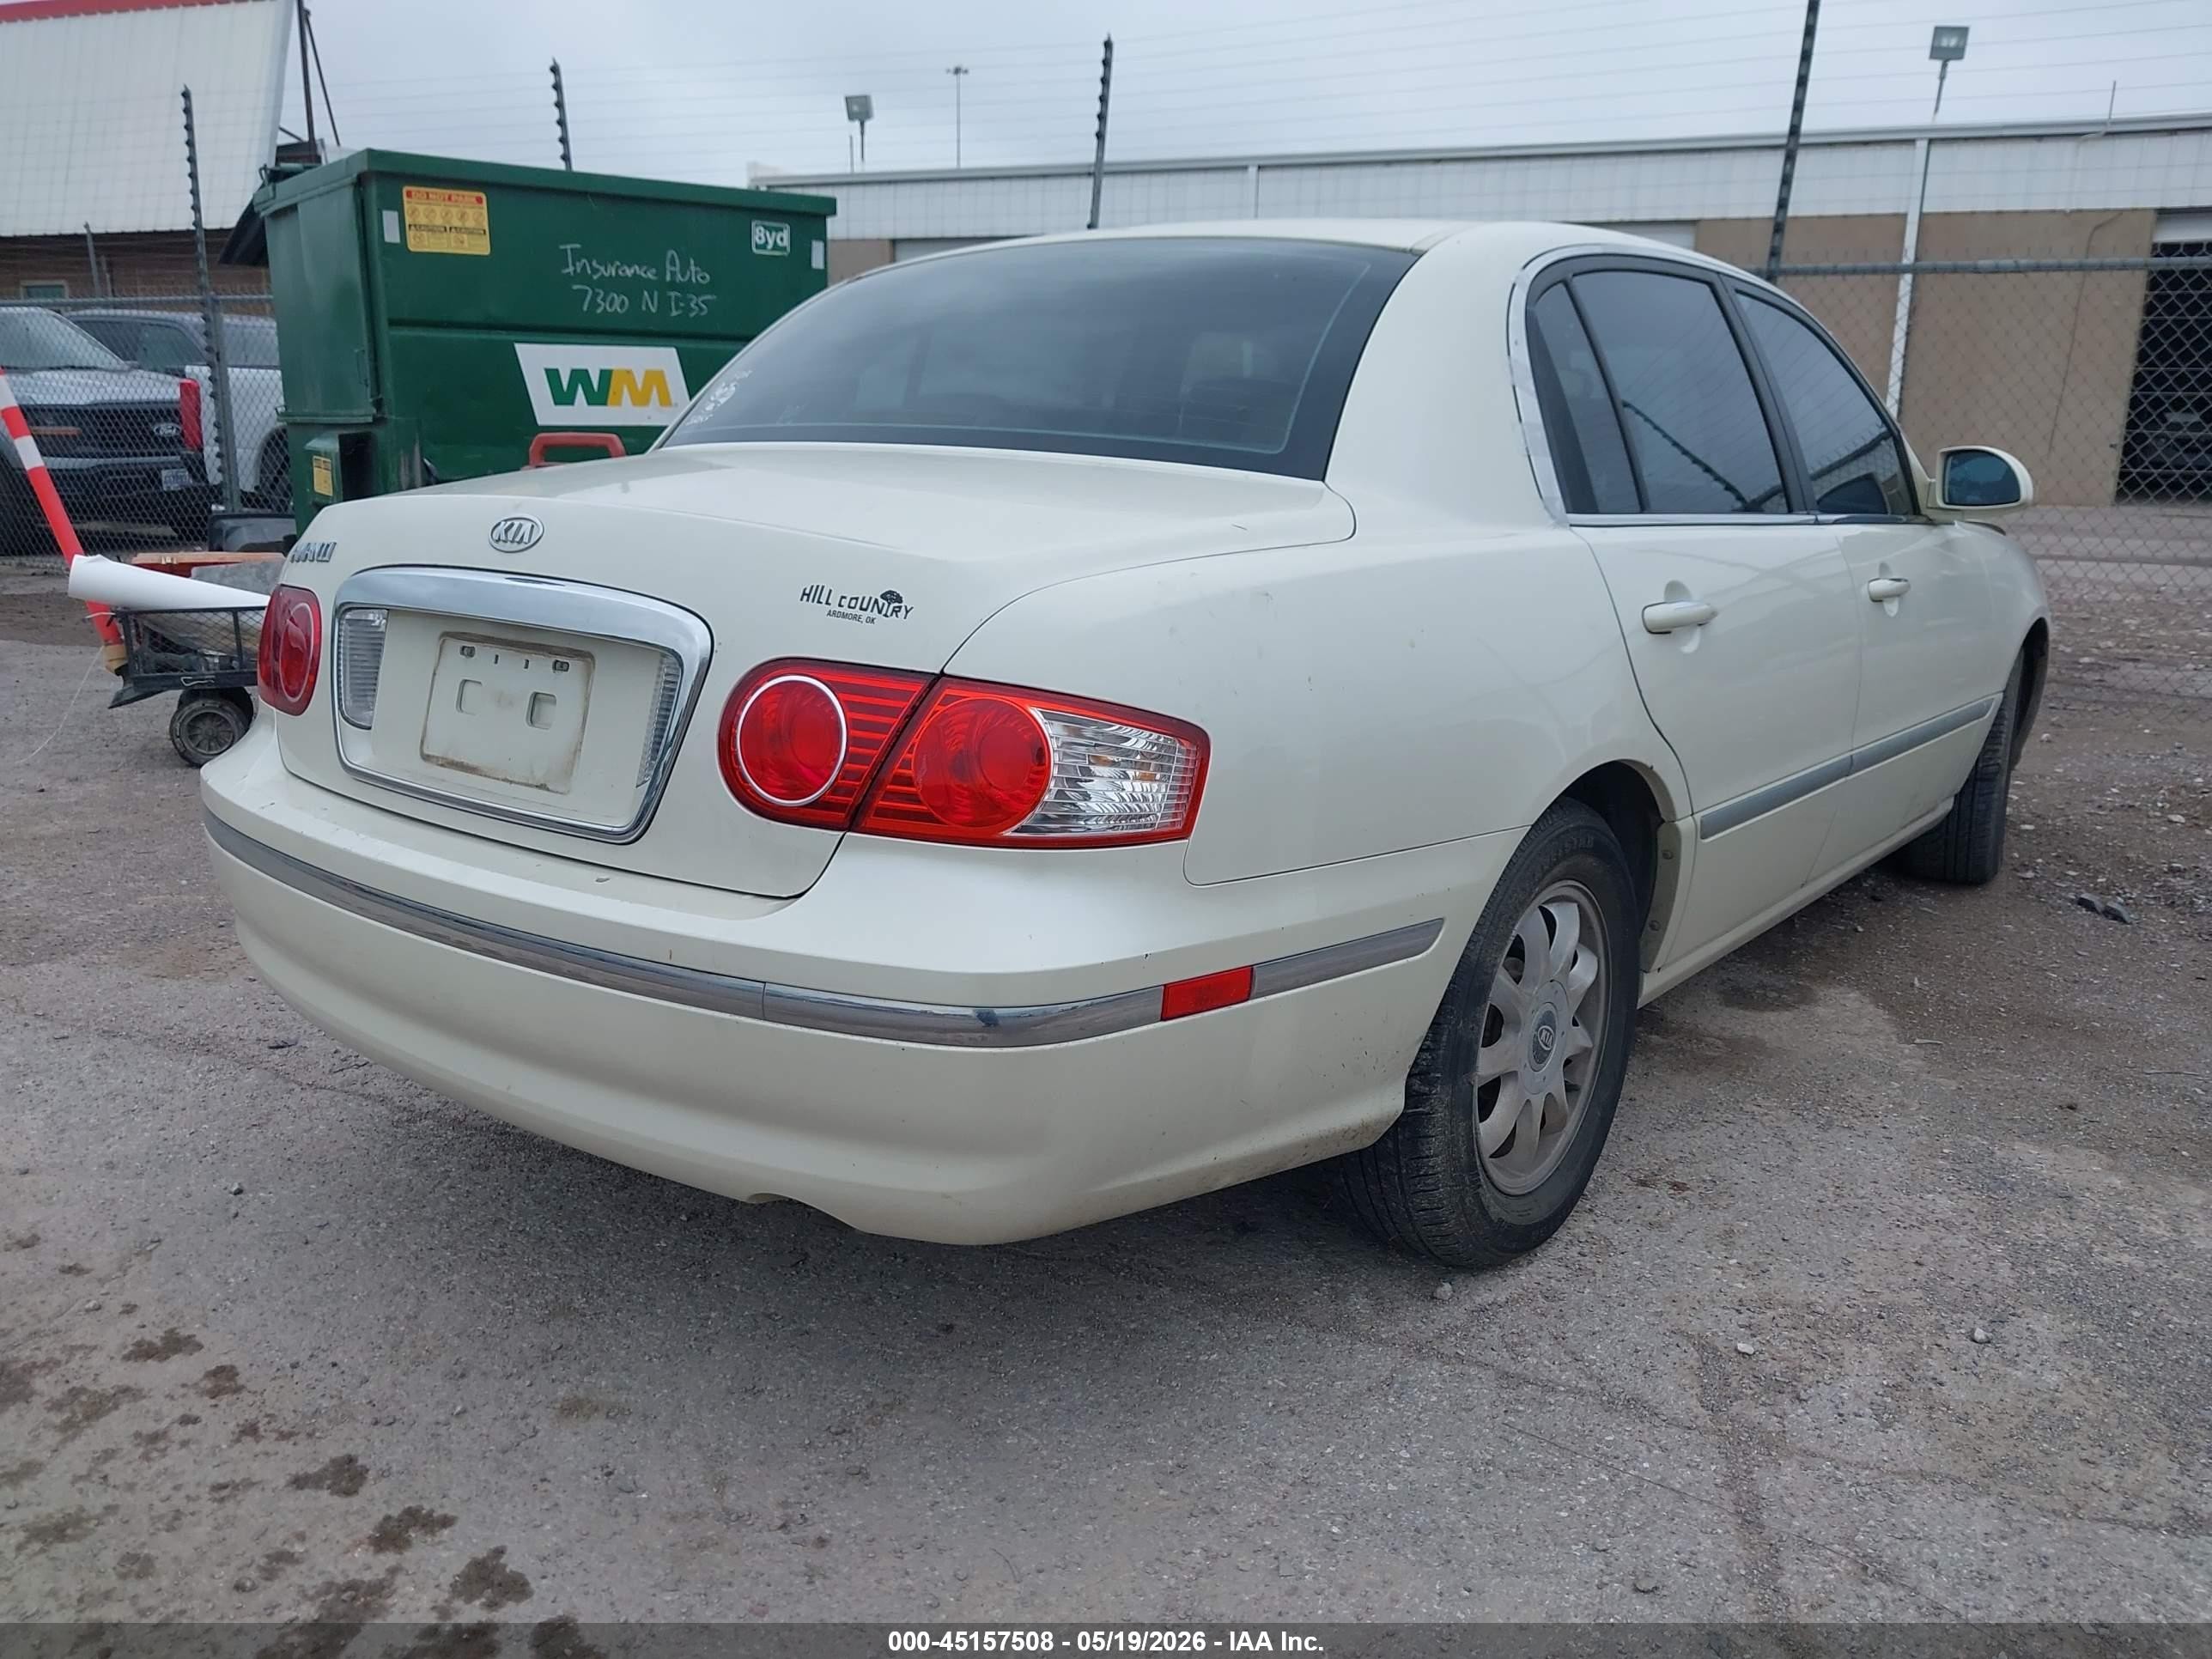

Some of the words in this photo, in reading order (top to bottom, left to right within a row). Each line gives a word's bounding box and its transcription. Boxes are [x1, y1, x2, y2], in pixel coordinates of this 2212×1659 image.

[756, 225, 787, 249] 8yd
[559, 244, 659, 280] Insurance
[665, 249, 711, 284] Auto
[572, 284, 629, 314] 7300
[641, 289, 659, 313] N
[666, 290, 718, 318] I-35
[544, 368, 672, 406] WM
[493, 521, 535, 544] KIA
[799, 585, 832, 605] HILL
[838, 591, 914, 619] COUNTRY
[826, 610, 864, 623] ARDMORE,
[866, 616, 876, 624] OK
